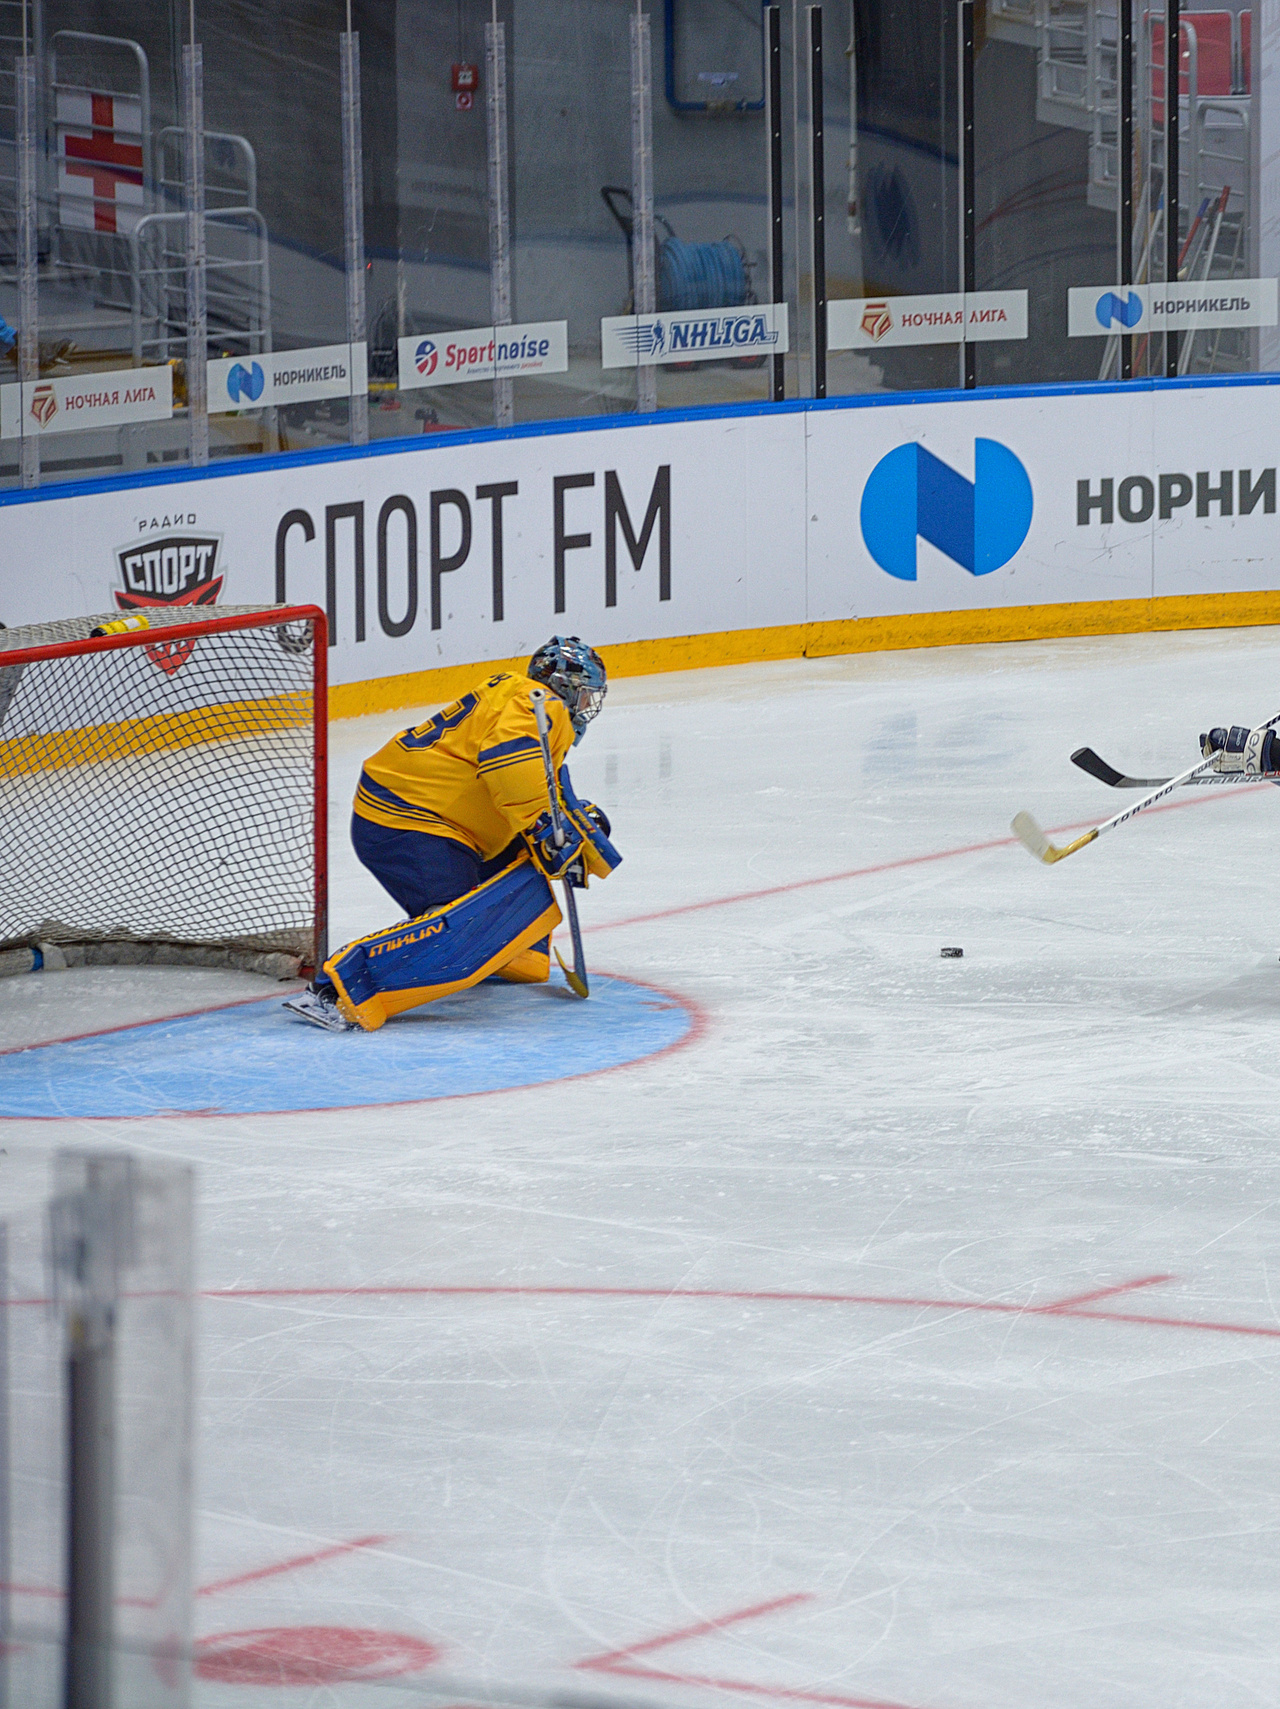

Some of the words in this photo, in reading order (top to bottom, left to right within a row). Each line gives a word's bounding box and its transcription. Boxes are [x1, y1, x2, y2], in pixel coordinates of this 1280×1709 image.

[902, 311, 964, 328] НОЧНАЯ
[968, 308, 1008, 325] ЛИГА
[1153, 297, 1251, 316] НОРНИКЕЛЬ
[671, 315, 766, 352] NHLIGA
[272, 365, 347, 388] НОРНИКЕЛЬ
[65, 391, 120, 411] НОЧНАЯ
[122, 386, 156, 404] ЛИГА
[138, 513, 197, 533] РАДИО
[124, 544, 214, 595] СПОРТ
[275, 480, 519, 655] СПОРТ
[552, 464, 671, 614] FM
